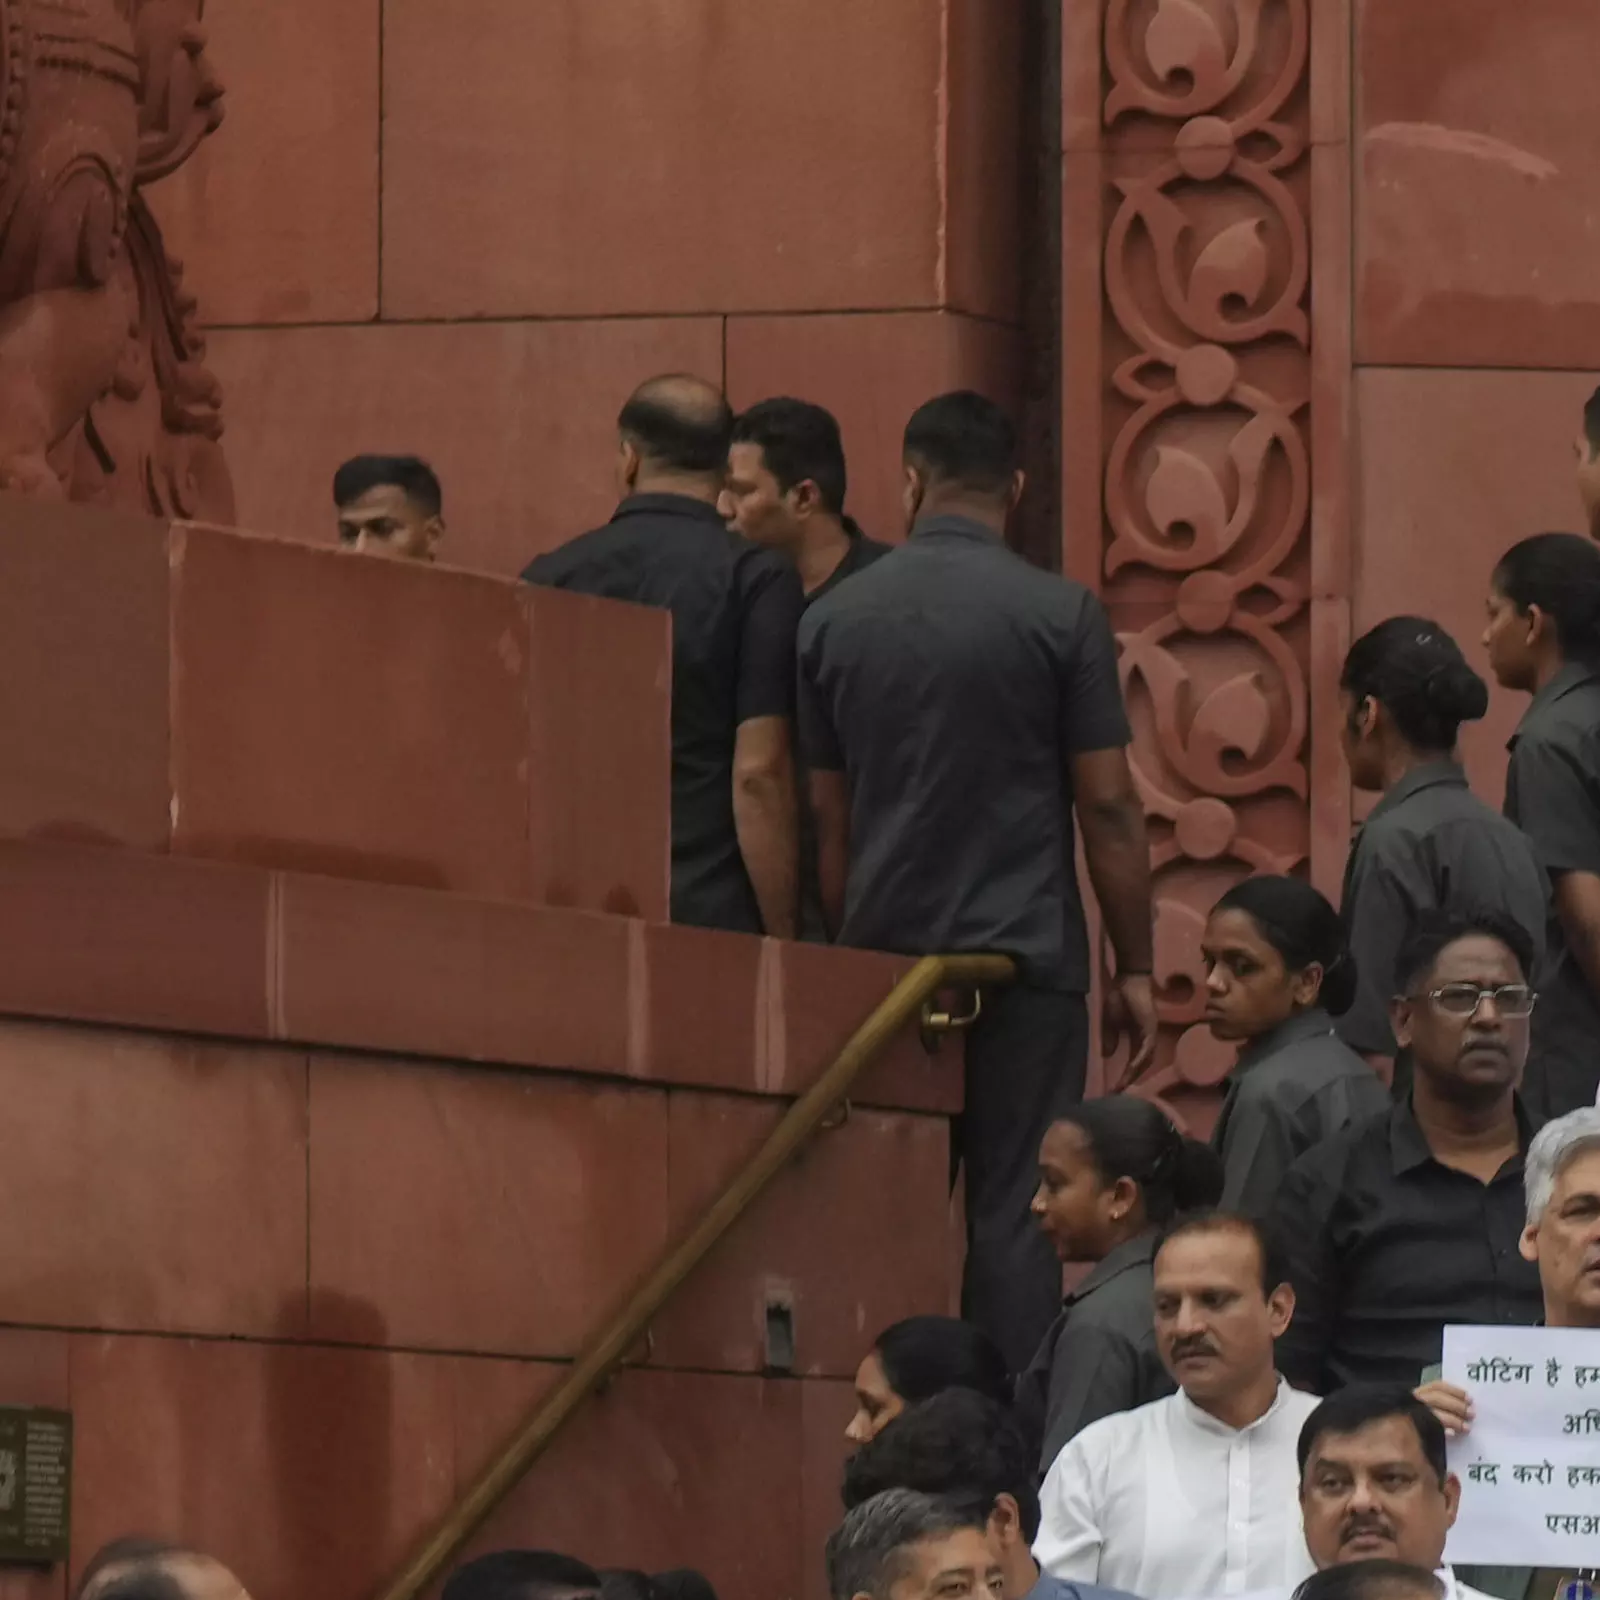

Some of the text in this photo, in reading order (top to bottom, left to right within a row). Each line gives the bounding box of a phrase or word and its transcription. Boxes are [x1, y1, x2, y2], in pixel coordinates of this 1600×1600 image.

[1467, 1356, 1534, 1385] वोटिंग
[1545, 1358, 1562, 1388] है
[1467, 1457, 1501, 1484] बंद
[1513, 1460, 1554, 1485] करो
